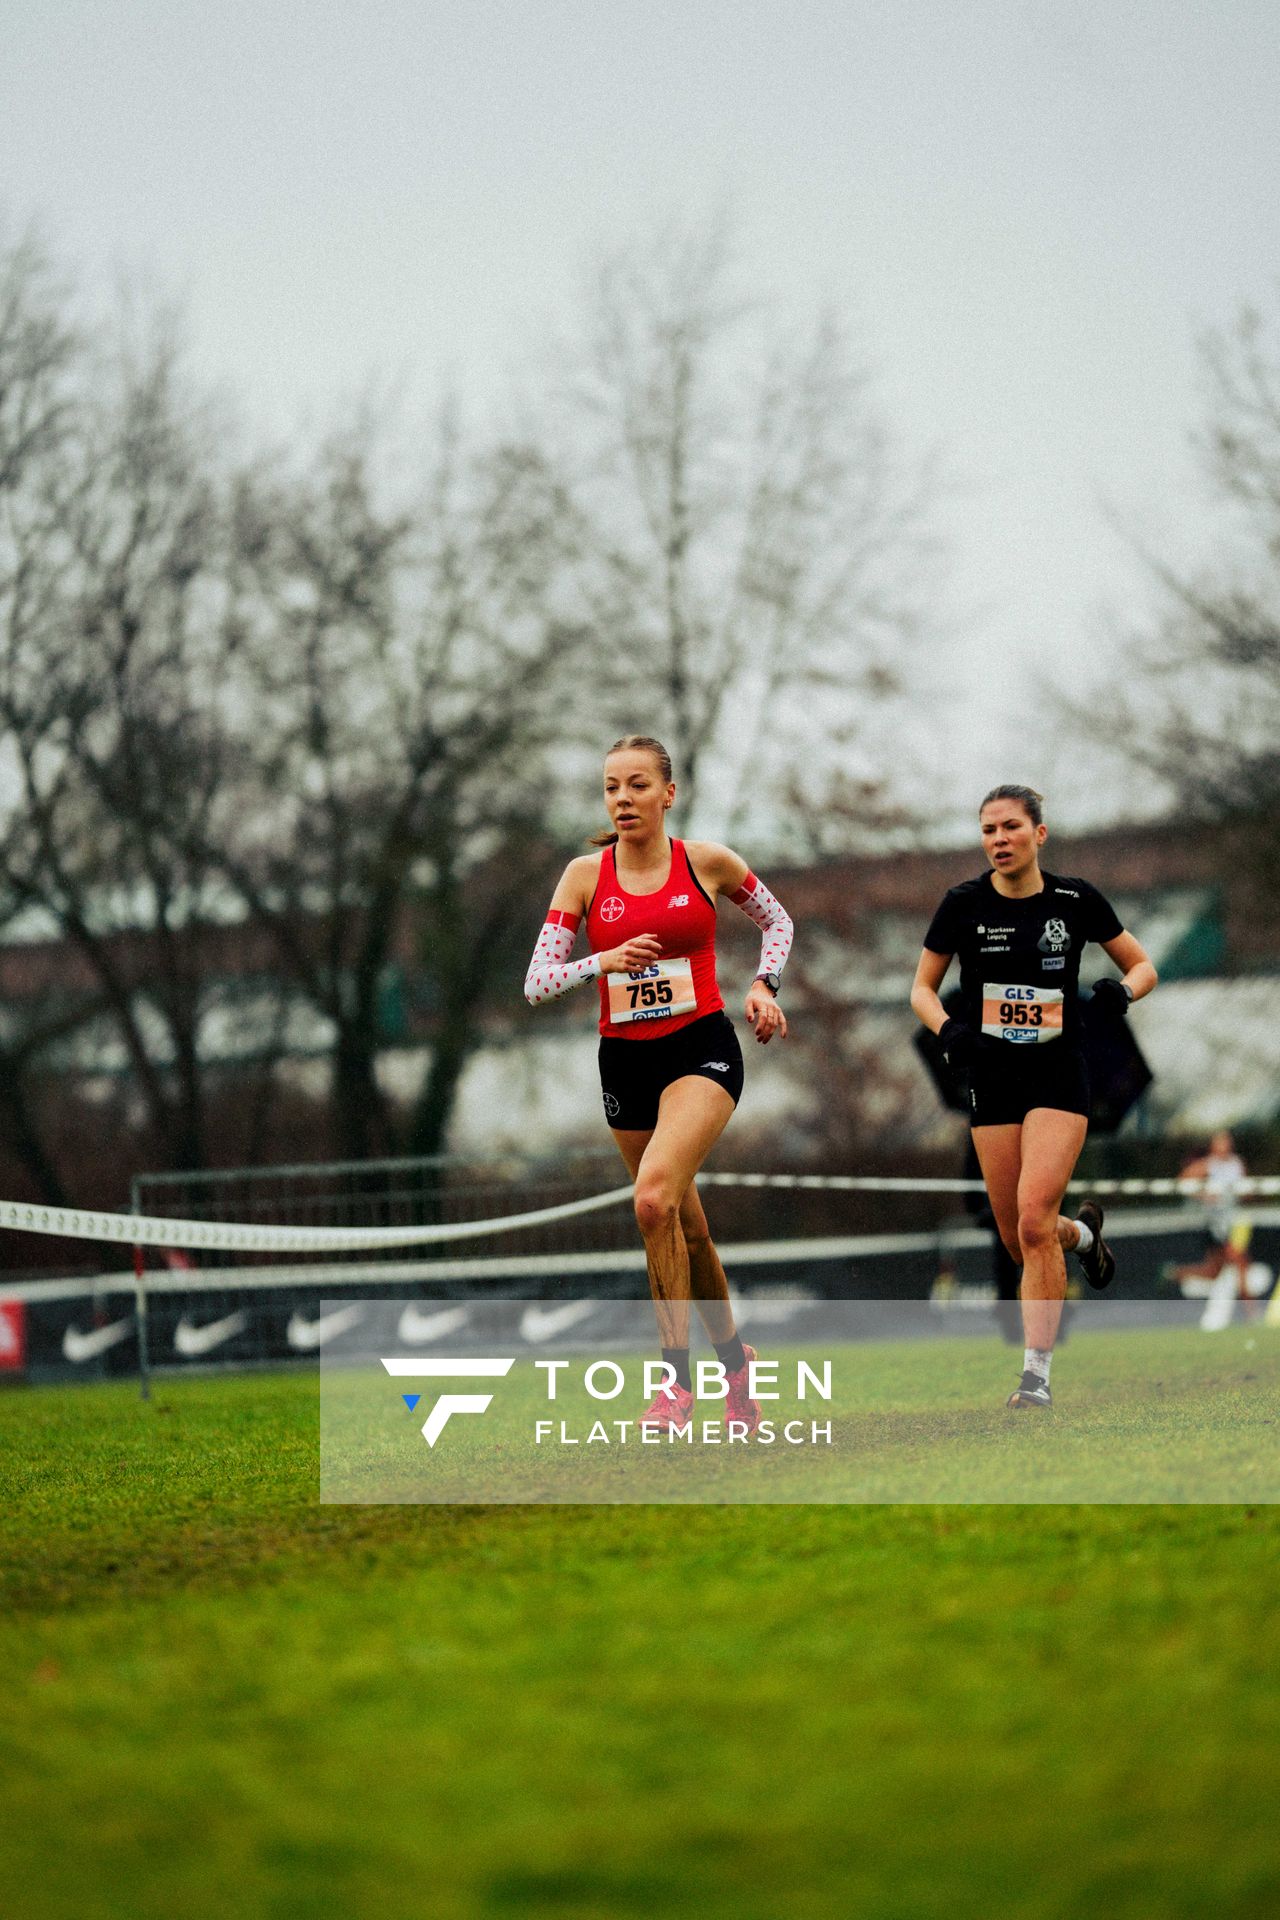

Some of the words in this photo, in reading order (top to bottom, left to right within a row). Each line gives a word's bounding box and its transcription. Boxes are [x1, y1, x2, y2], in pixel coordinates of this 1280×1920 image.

[1051, 944, 1063, 952] DT
[626, 980, 673, 1008] 755
[1005, 987, 1035, 1000] GLS
[647, 1009, 670, 1019] PLAN
[1000, 1003, 1043, 1026] 953
